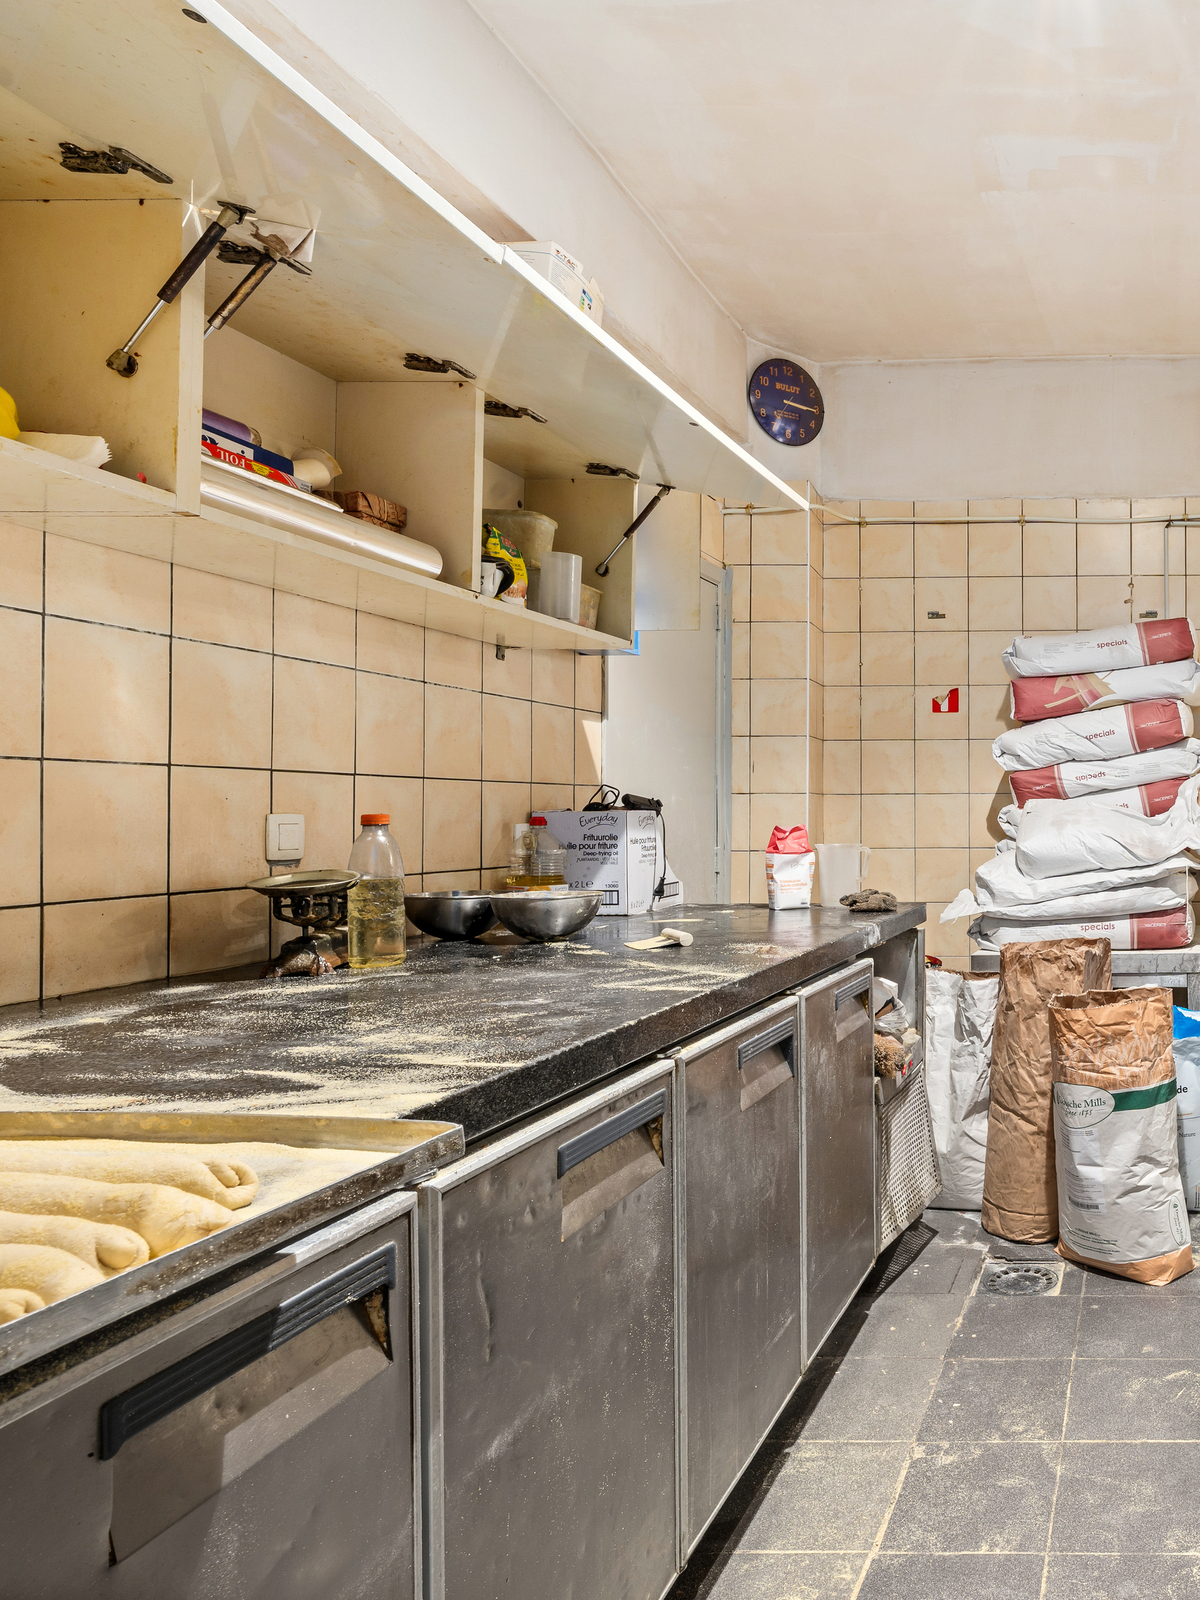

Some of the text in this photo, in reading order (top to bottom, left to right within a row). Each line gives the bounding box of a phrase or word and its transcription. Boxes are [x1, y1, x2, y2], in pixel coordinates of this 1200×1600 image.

[769, 366, 778, 377] 11
[782, 366, 793, 377] 12
[759, 375, 769, 386] 10
[800, 375, 804, 384] 1
[775, 382, 800, 394] BULUT
[809, 388, 815, 398] 2
[755, 389, 761, 399] 9
[760, 408, 766, 417] 8
[813, 405, 819, 415] 3
[771, 421, 777, 431] 7
[809, 420, 815, 429] 4
[785, 429, 791, 439] 6
[799, 428, 805, 438] 5
[216, 449, 246, 469] FOIL
[1096, 639, 1128, 649] specials
[1085, 728, 1116, 740] specials
[1075, 771, 1106, 782] specials
[579, 813, 618, 828] Everyday
[579, 843, 596, 851] pour
[1080, 922, 1115, 932] specials
[1084, 1097, 1106, 1108] Mills
